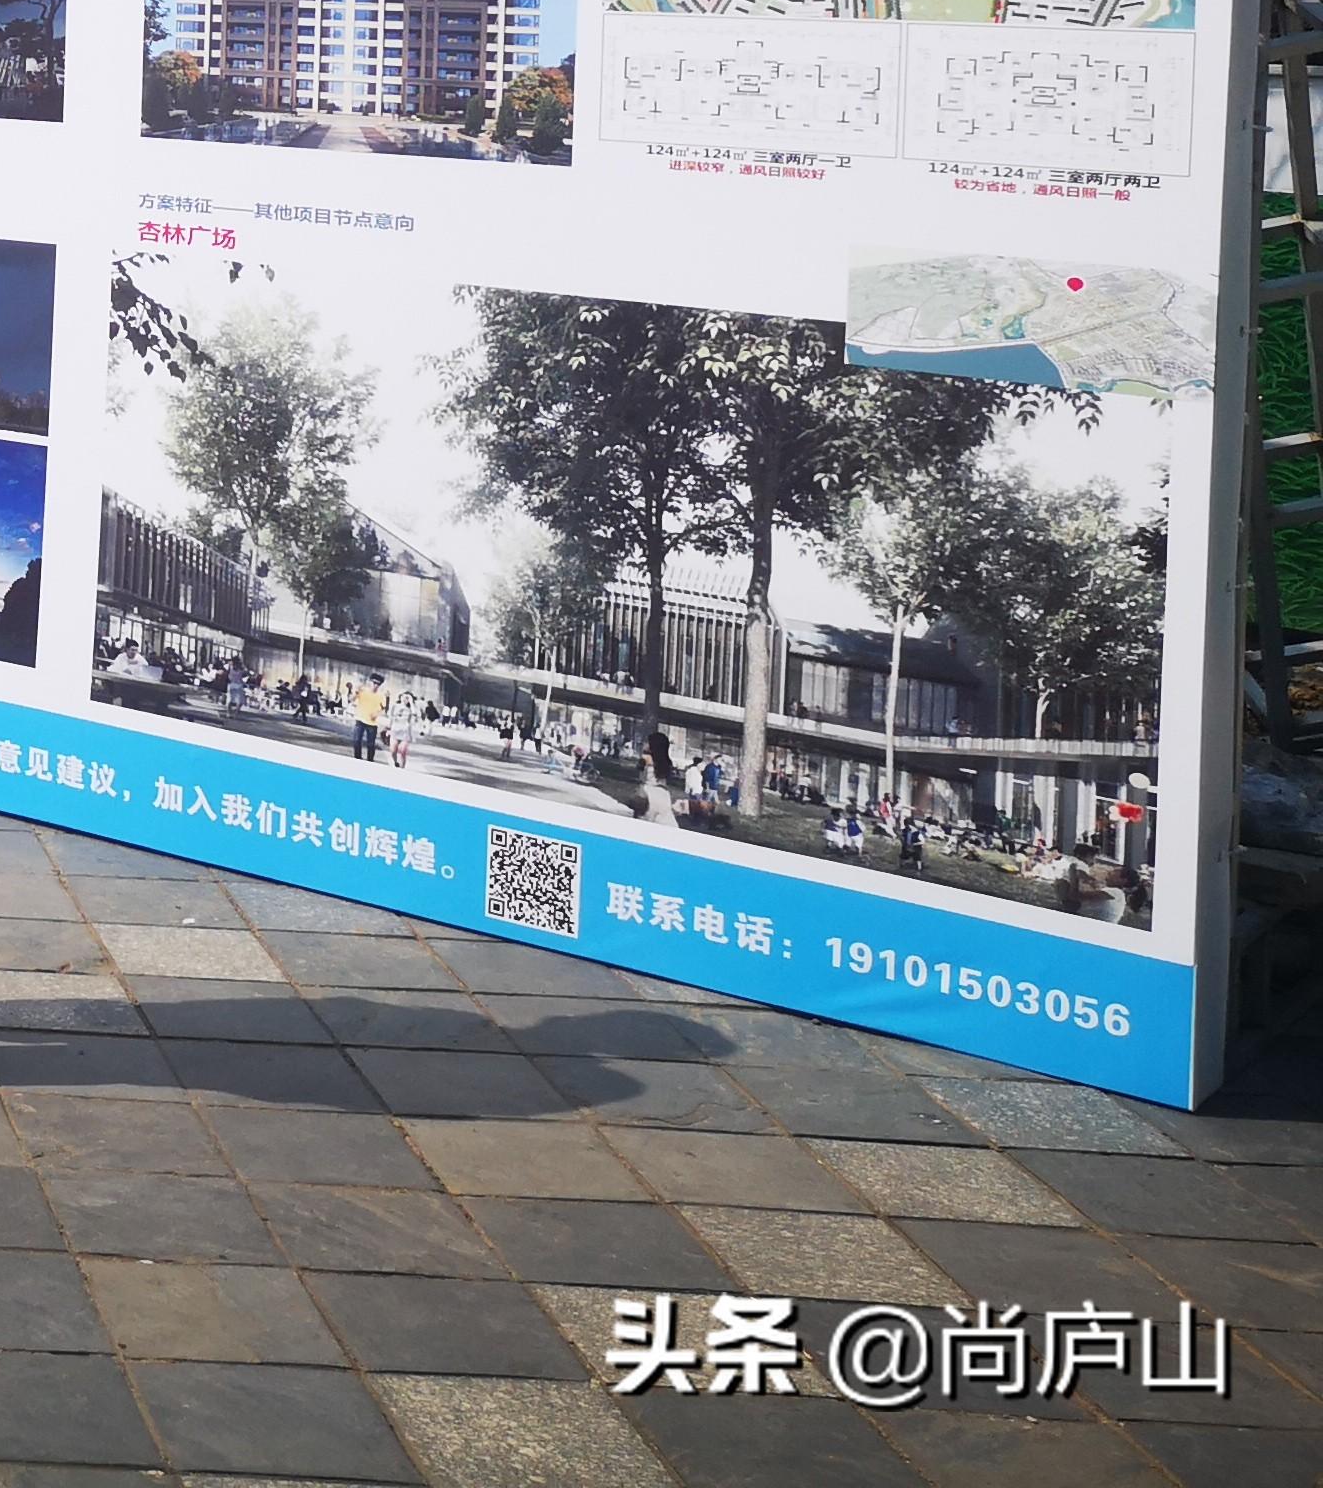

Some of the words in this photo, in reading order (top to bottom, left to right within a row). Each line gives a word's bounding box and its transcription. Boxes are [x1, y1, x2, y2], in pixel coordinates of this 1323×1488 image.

[138, 193, 415, 233] 方案特征——其他项目节点意向
[138, 220, 237, 250] 杏林广场
